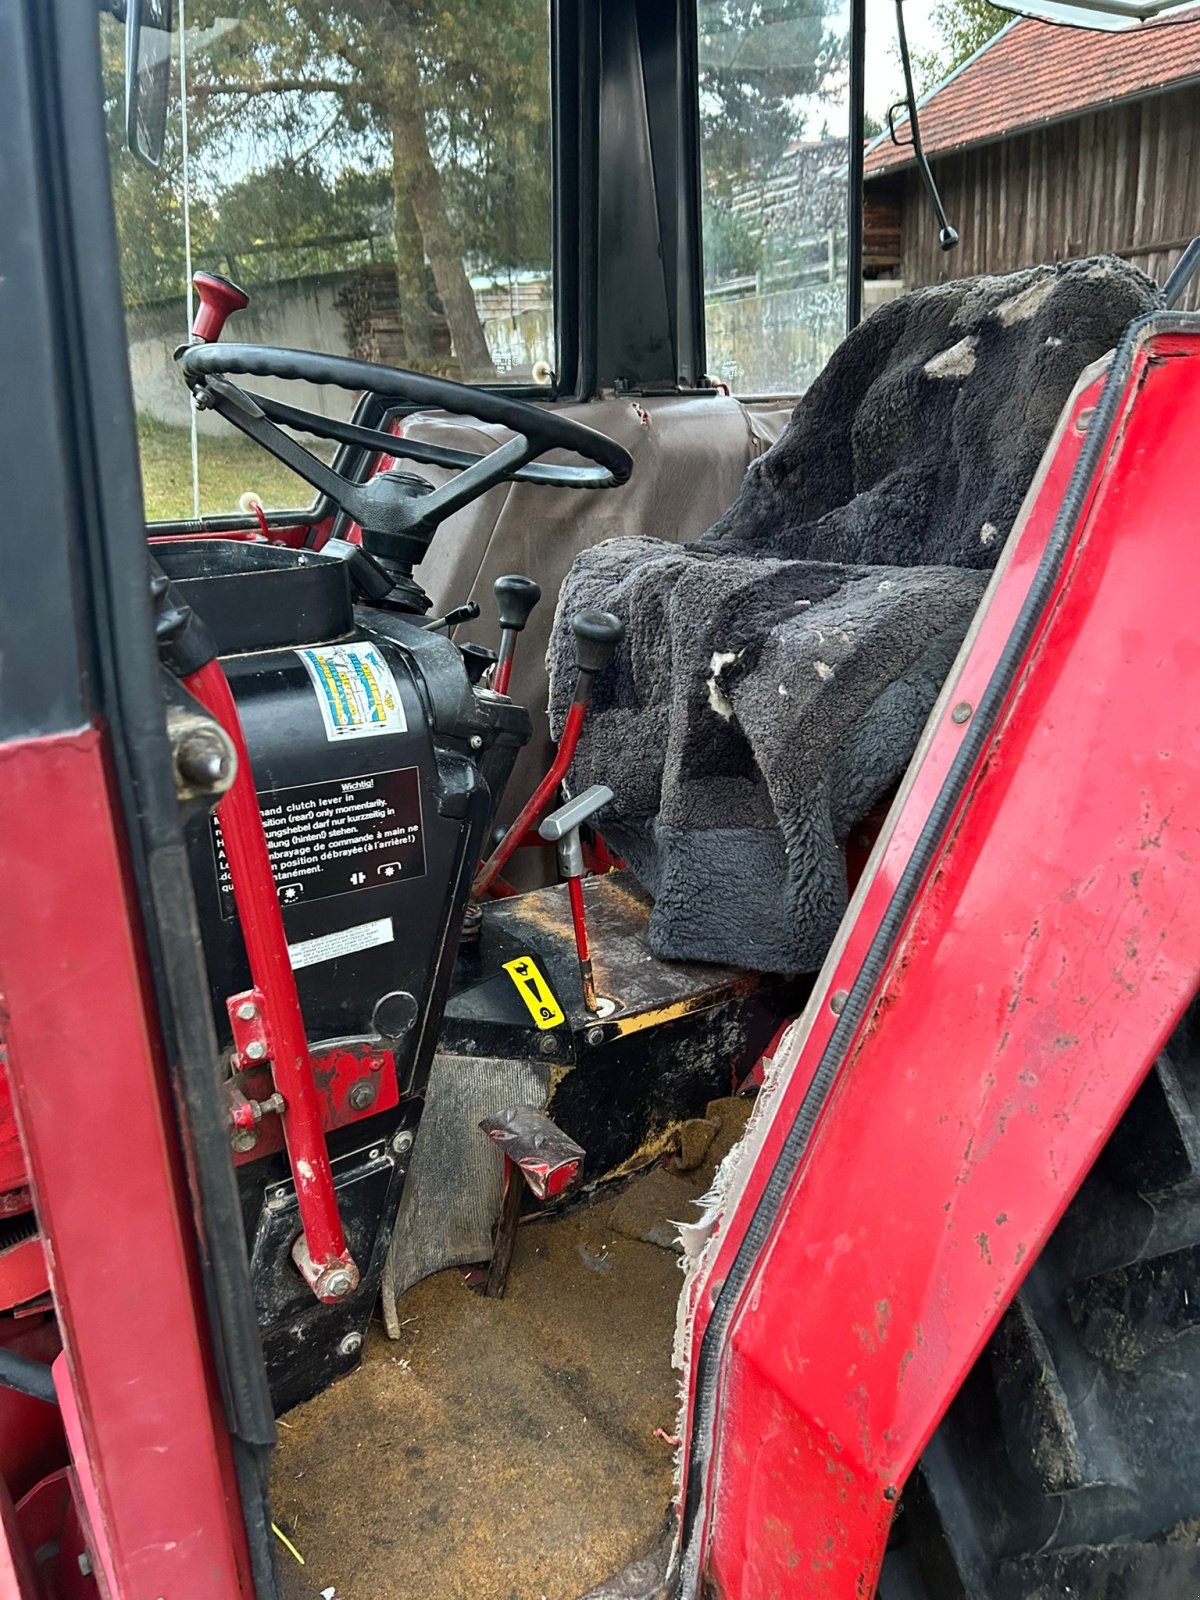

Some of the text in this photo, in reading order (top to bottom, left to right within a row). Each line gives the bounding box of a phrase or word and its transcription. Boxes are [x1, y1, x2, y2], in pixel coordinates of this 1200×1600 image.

[341, 779, 374, 792] Wichtig!
[262, 799, 387, 827] sition (rear!) only momentarily.
[286, 800, 316, 812] clutch
[319, 796, 342, 806] lever
[345, 793, 354, 801] in
[265, 807, 395, 838] ungshebel darf nur kurzzeitig in
[267, 826, 359, 849] llung (hinten!) stehen.
[313, 843, 325, 851] de
[328, 833, 374, 848] commande
[376, 831, 382, 839] à
[384, 827, 405, 837] main
[273, 865, 324, 880] ntanément.
[280, 856, 318, 870] position
